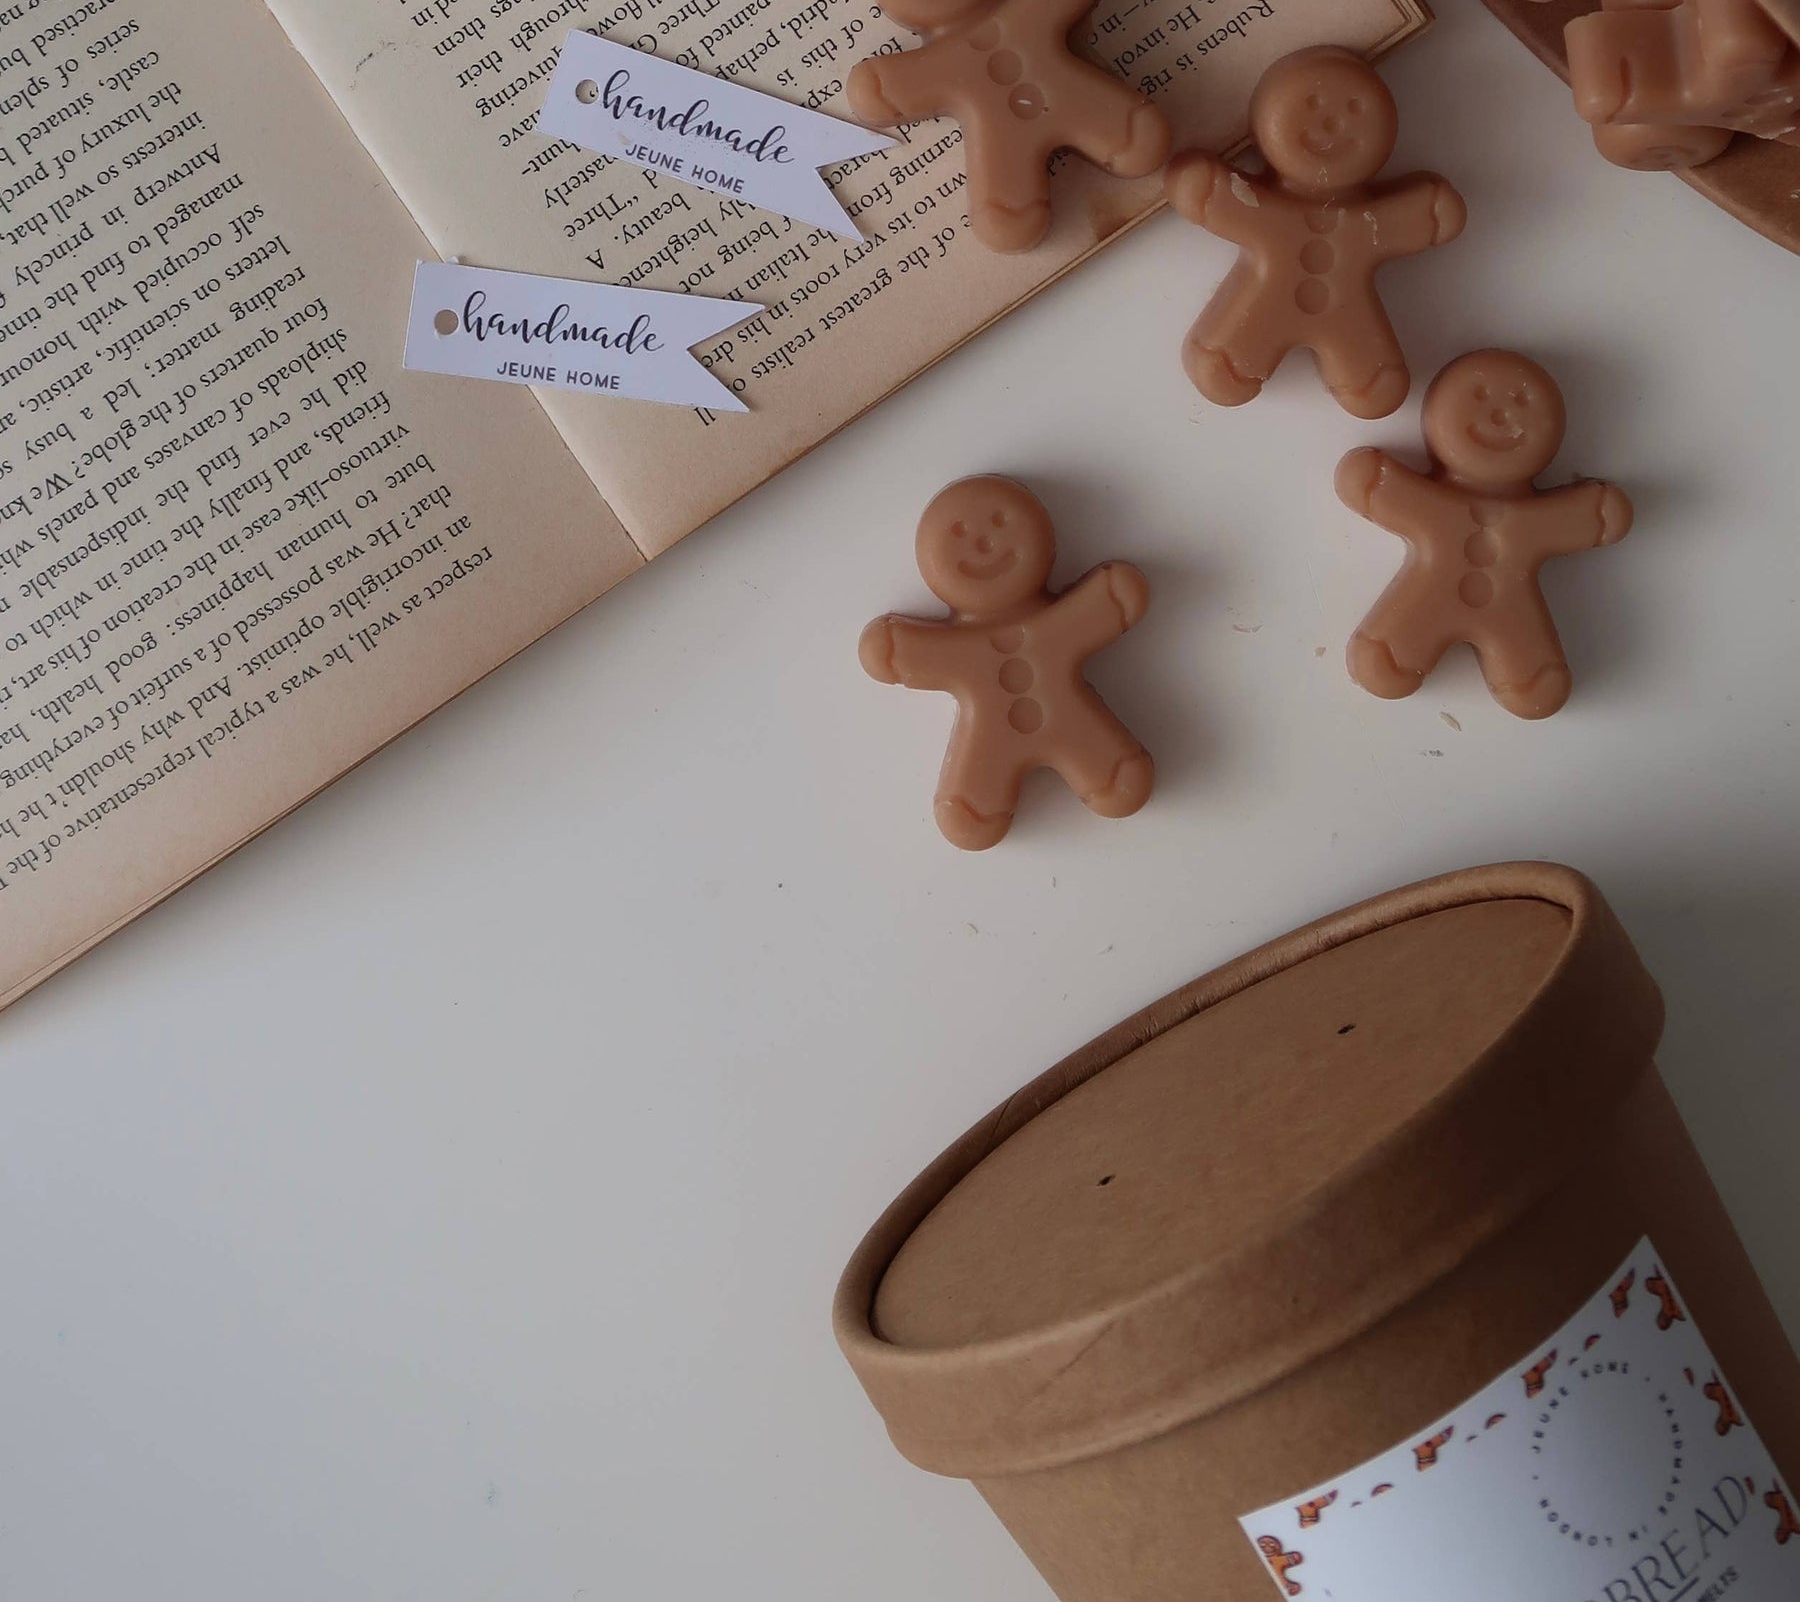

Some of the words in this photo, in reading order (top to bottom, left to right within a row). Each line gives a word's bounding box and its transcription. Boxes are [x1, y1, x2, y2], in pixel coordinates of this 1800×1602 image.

[408, 5, 439, 28] in
[838, 17, 865, 50] of
[1164, 2, 1203, 33] He
[430, 15, 487, 57] them
[799, 36, 839, 69] this
[96, 49, 160, 93] castle,
[454, 48, 504, 89] their
[774, 66, 799, 88] is
[1174, 51, 1198, 72] is
[14, 90, 95, 157] situated
[602, 69, 795, 164] handmade
[120, 109, 207, 170] interests
[95, 163, 120, 186] so
[625, 144, 684, 173] JEUNE
[691, 164, 745, 194] HOME
[46, 182, 96, 225] well
[151, 171, 245, 247] managed
[612, 190, 693, 246] beauty.
[912, 193, 937, 216] to
[0, 210, 50, 246] that,
[885, 209, 917, 235] its
[126, 233, 152, 255] to
[223, 233, 292, 282] letters
[583, 246, 605, 271] A
[715, 219, 781, 266] being
[841, 230, 888, 270] very
[895, 244, 931, 274] the
[930, 225, 956, 259] of
[78, 249, 126, 294] find
[679, 260, 716, 291] not
[742, 241, 812, 291] Italian
[42, 281, 80, 310] the
[190, 276, 222, 302] on
[788, 262, 841, 306] roots
[817, 266, 893, 331] greatest
[281, 296, 329, 335] four
[463, 290, 665, 355] handmade
[763, 298, 794, 321] in
[93, 296, 191, 363] scientific,
[735, 314, 773, 344] his
[197, 325, 280, 388] quarters
[749, 325, 817, 380] realists
[17, 360, 94, 413] artistic,
[330, 359, 368, 397] did
[497, 361, 557, 382] JEUNE
[566, 370, 621, 390] HOME
[136, 399, 173, 429] the
[171, 382, 198, 416] of
[298, 385, 332, 412] he
[246, 410, 292, 448] ever
[194, 443, 242, 488] find
[282, 423, 411, 513] virtuoso-like
[28, 471, 75, 501] We
[153, 478, 190, 508] the
[240, 506, 283, 541] ease
[364, 517, 403, 548] He
[17, 504, 152, 600] indispensable
[215, 532, 245, 556] in
[323, 543, 367, 576] was
[181, 550, 218, 580] the
[421, 544, 494, 601] respect
[100, 572, 183, 633] creation
[231, 563, 325, 644] possessed
[400, 592, 423, 615] as
[75, 627, 102, 660] of
[206, 630, 232, 664] of
[346, 610, 402, 653] well,
[45, 642, 84, 671] his
[191, 646, 208, 662] a
[321, 642, 355, 668] he
[9, 662, 48, 690] art,
[127, 655, 194, 707] surfeit
[279, 663, 323, 696] was
[263, 688, 280, 705] a
[104, 699, 130, 732] of
[194, 699, 266, 759] typical
[0, 714, 105, 790] everything
[62, 744, 197, 838] representative
[5, 847, 40, 875] the
[37, 832, 62, 864] of
[1532, 1386, 1570, 1454] JEUNE
[1585, 1475, 1748, 1602] BREAD
